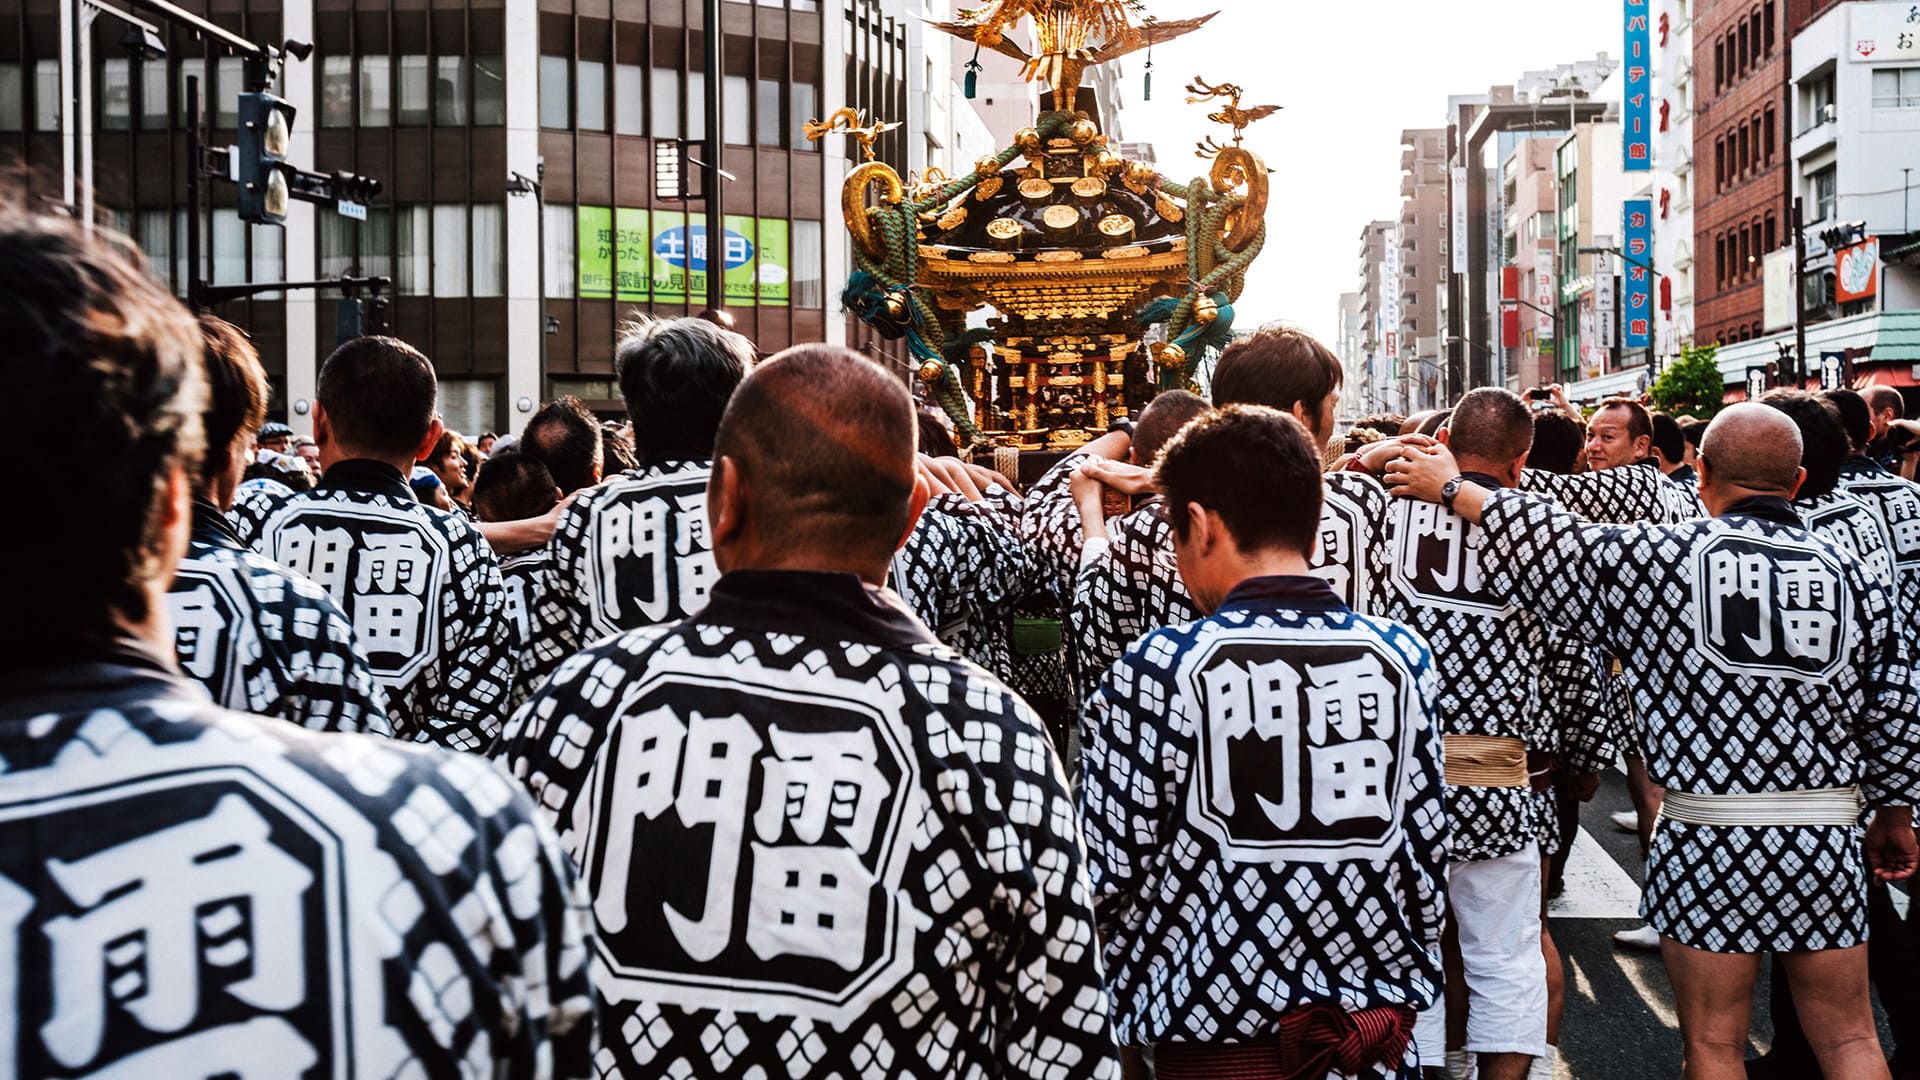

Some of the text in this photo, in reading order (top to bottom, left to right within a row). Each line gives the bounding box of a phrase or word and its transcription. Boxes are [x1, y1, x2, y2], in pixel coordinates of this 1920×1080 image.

[1630, 211, 1648, 335] カラオケ館
